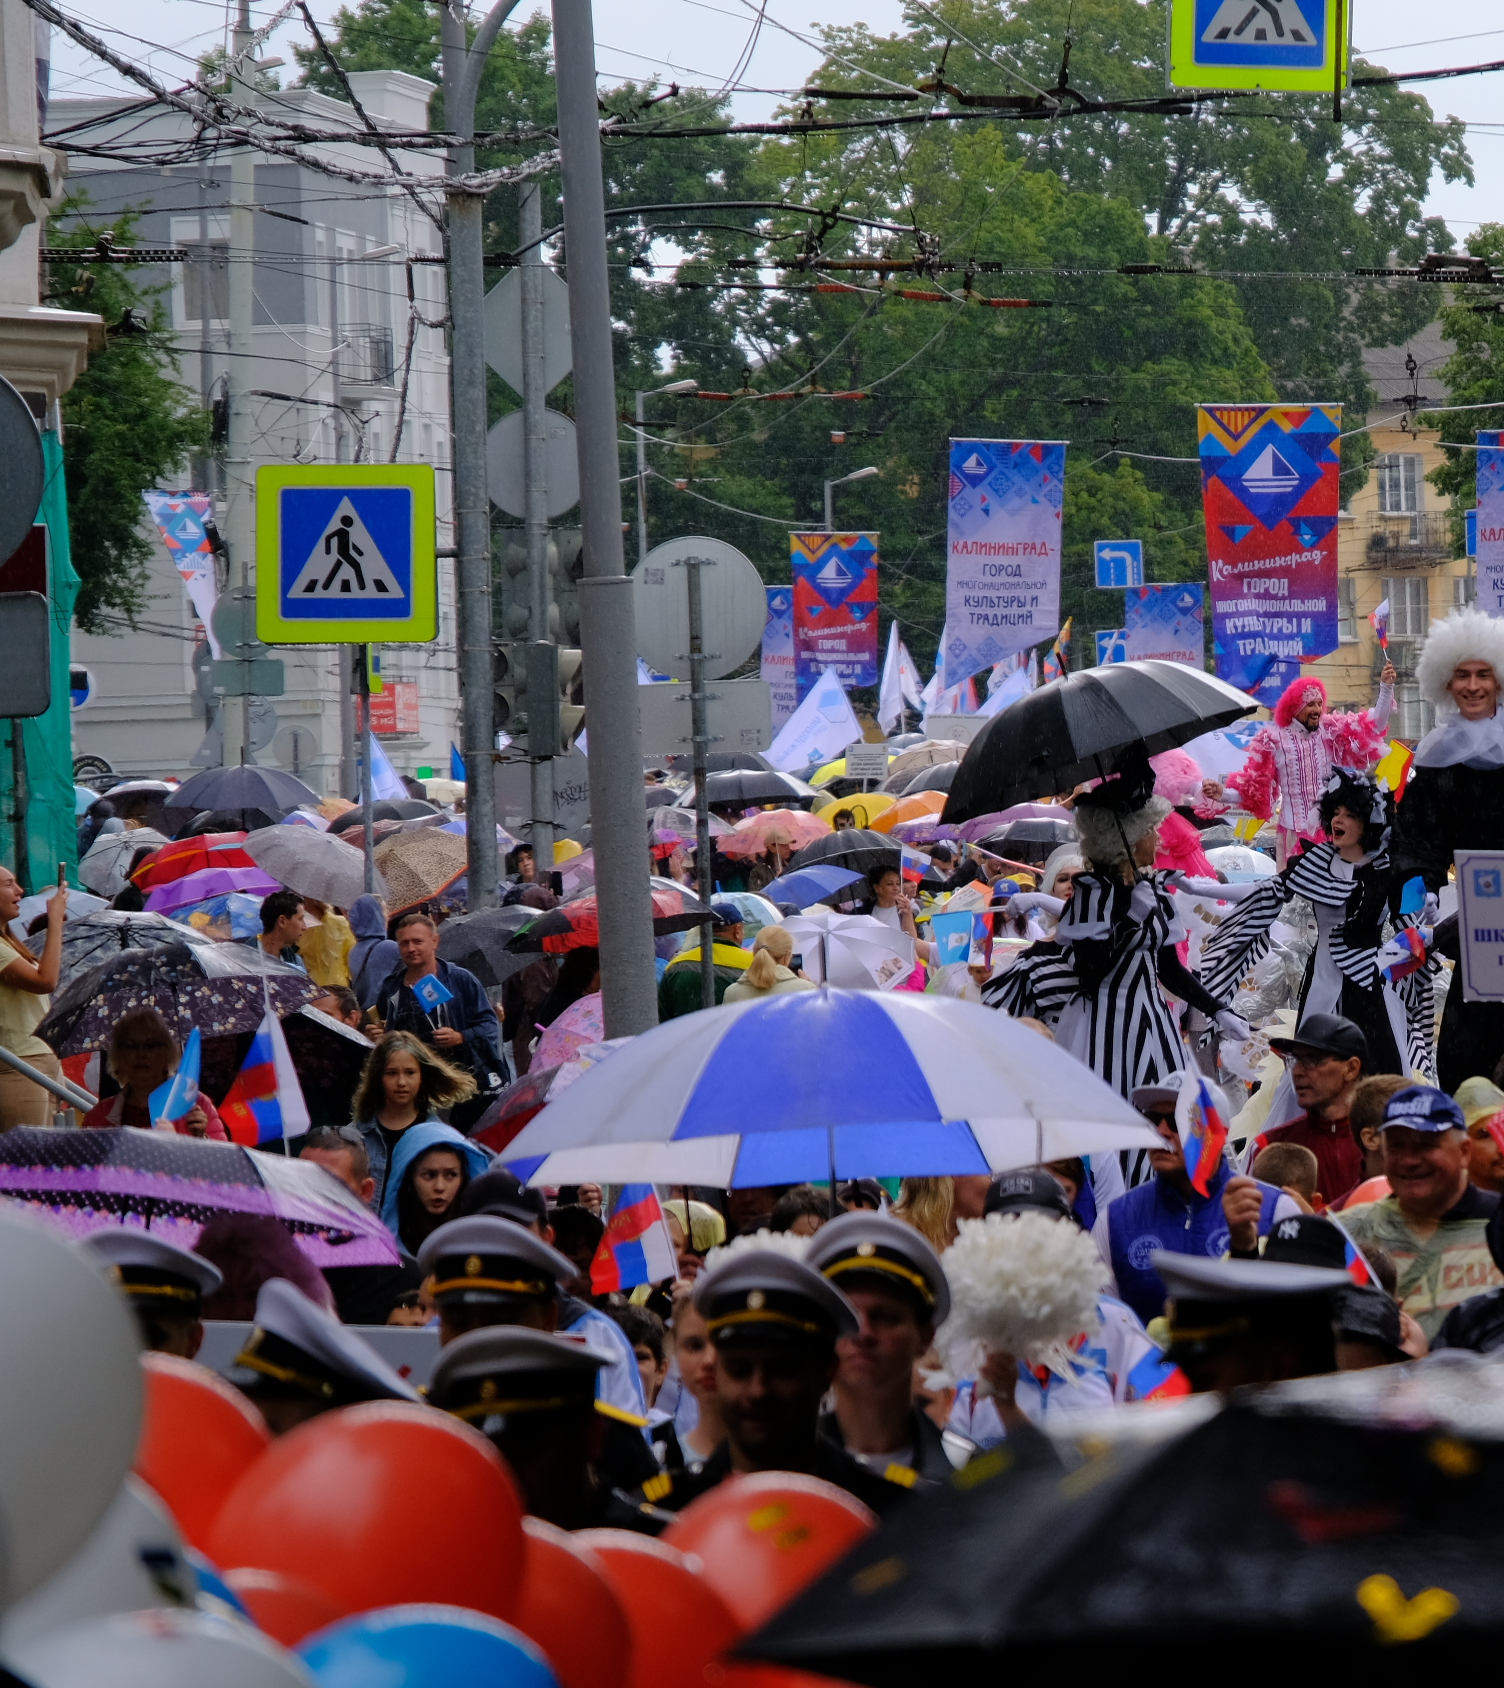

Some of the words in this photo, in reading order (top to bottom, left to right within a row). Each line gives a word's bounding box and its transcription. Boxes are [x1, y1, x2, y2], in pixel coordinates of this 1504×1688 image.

[952, 541, 1054, 557] КАЛИНИНГРАД-
[983, 564, 1021, 577] ГОРОД
[957, 580, 1046, 591] МНОГОНАЦИОНАЛЬНОЙ
[1243, 578, 1288, 596] ГОРОД
[964, 595, 1026, 608] КУЛЬТУРЫ
[1031, 595, 1038, 607] И
[969, 610, 1032, 627] ТРАДИЦИЙ
[1226, 616, 1297, 634] КУЛЬТУРЫ
[1301, 618, 1311, 633] И
[818, 640, 846, 651] ГОРОД
